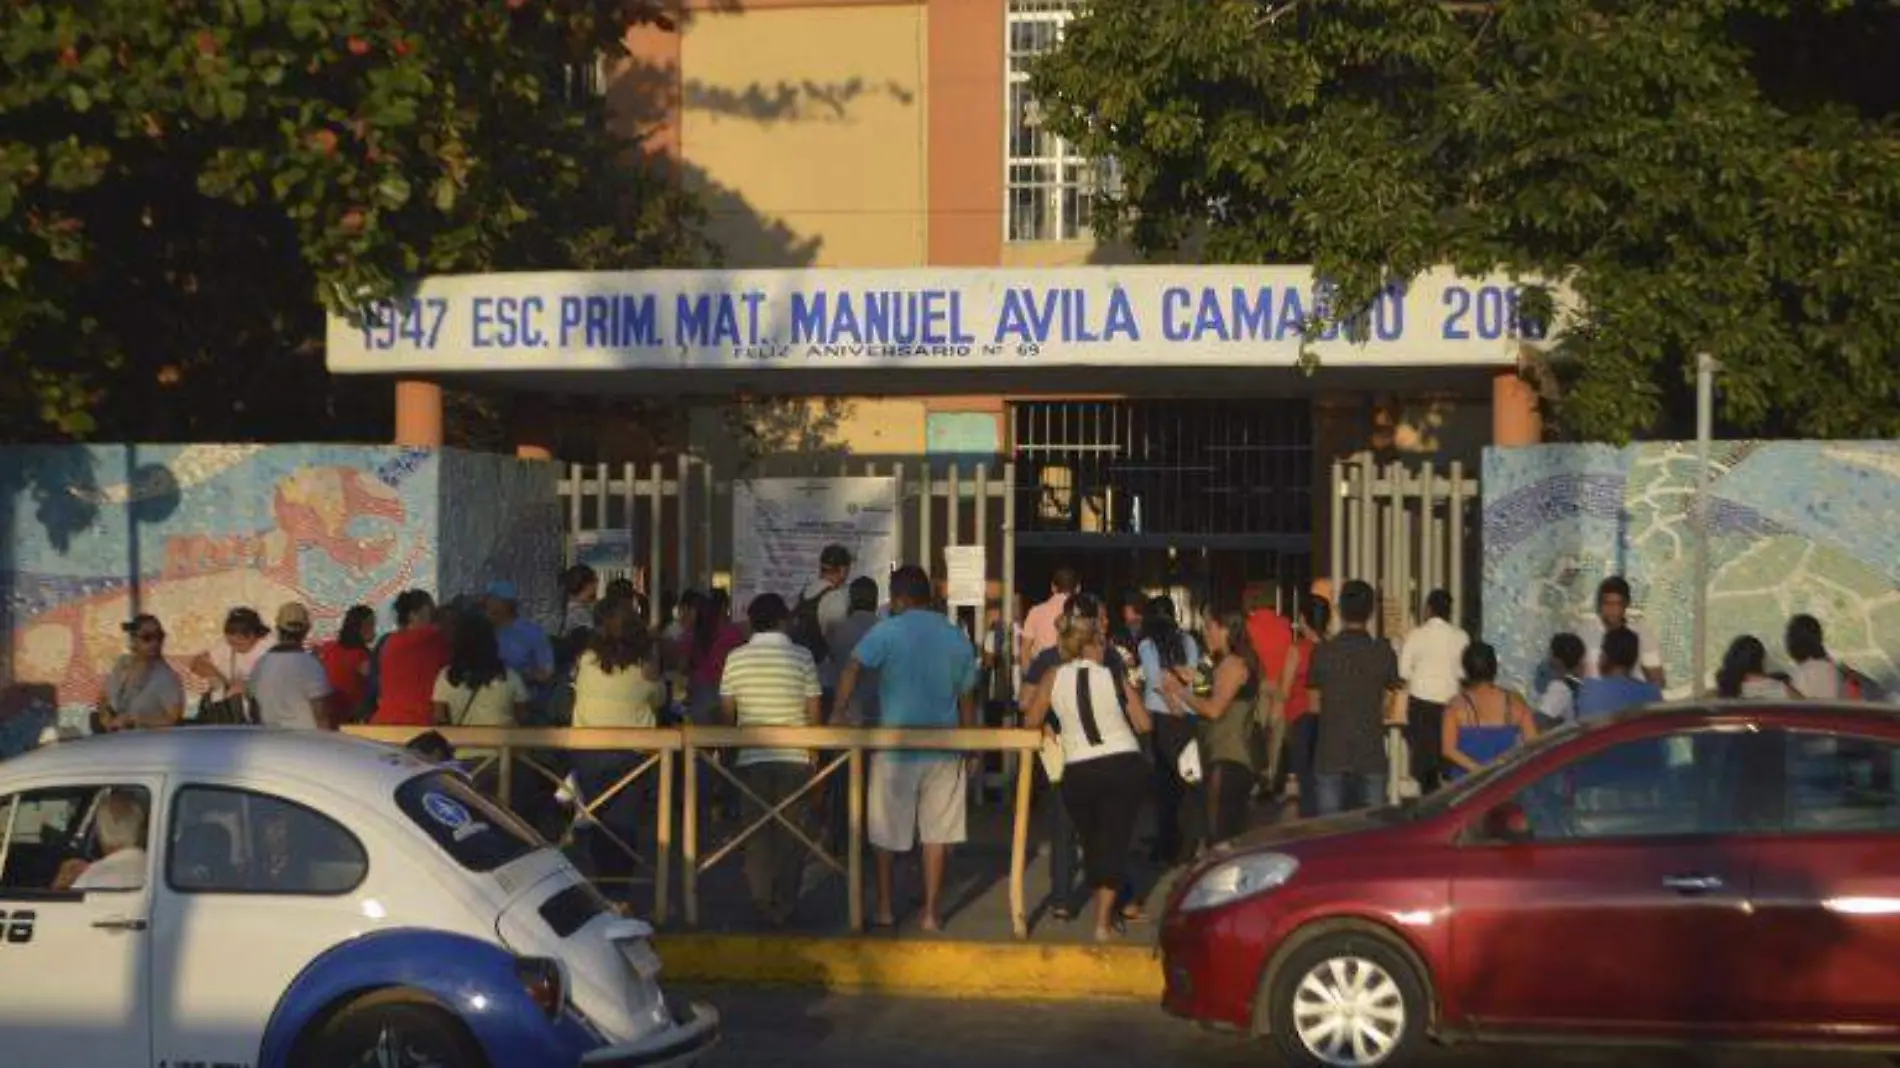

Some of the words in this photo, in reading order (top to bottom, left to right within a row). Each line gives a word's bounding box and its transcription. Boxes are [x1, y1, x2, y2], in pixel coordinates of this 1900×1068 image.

[471, 296, 548, 348] ESC.
[559, 295, 663, 347] PRIM.
[676, 291, 768, 346] MAT.
[790, 289, 975, 345] MANUEL
[998, 286, 1140, 342] AVILA
[733, 344, 790, 358] FELIZ
[806, 344, 971, 358] ANIVERSARIO
